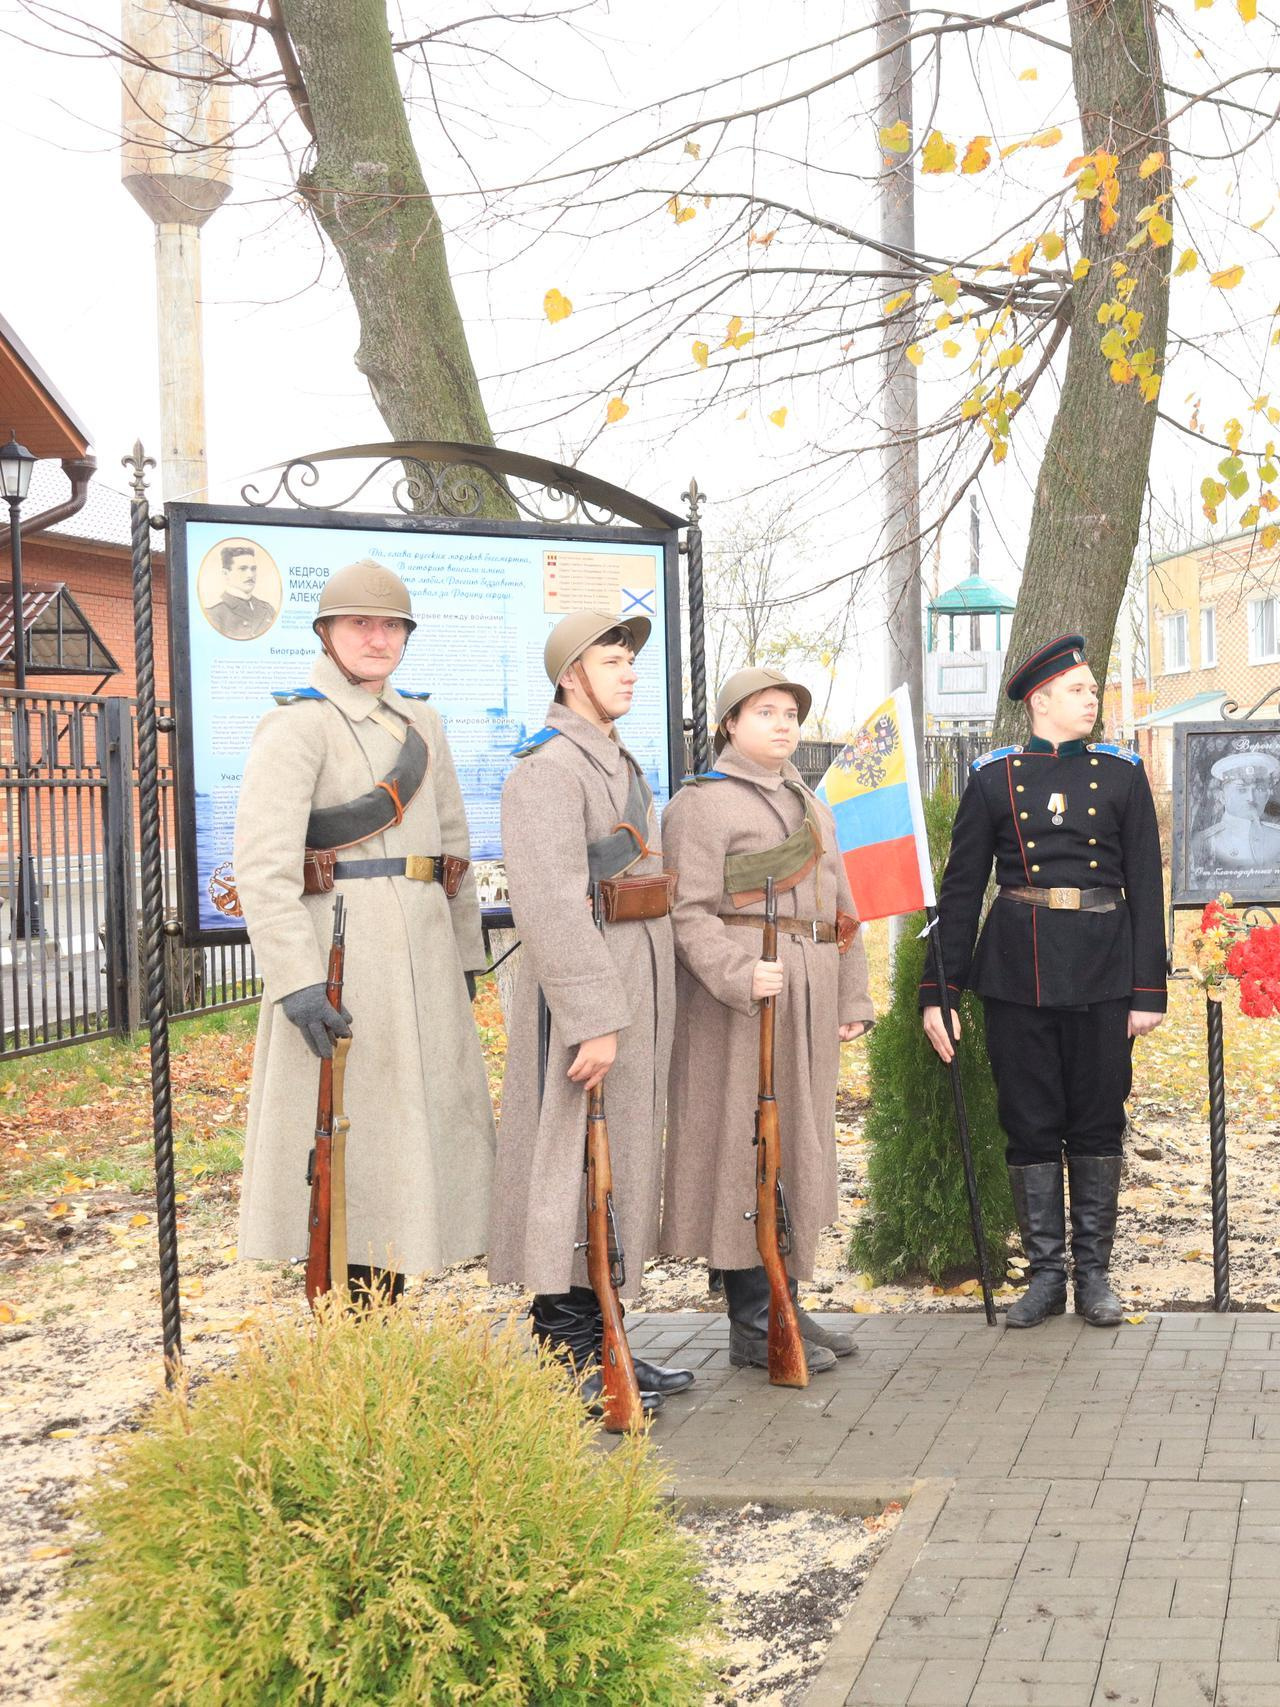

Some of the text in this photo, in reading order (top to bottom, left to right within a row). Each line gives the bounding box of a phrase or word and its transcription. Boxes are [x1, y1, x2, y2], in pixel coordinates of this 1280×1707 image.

[289, 566, 330, 578] КЕДРОВ
[289, 579, 326, 590] МИХАИ
[270, 647, 316, 656] Биография
